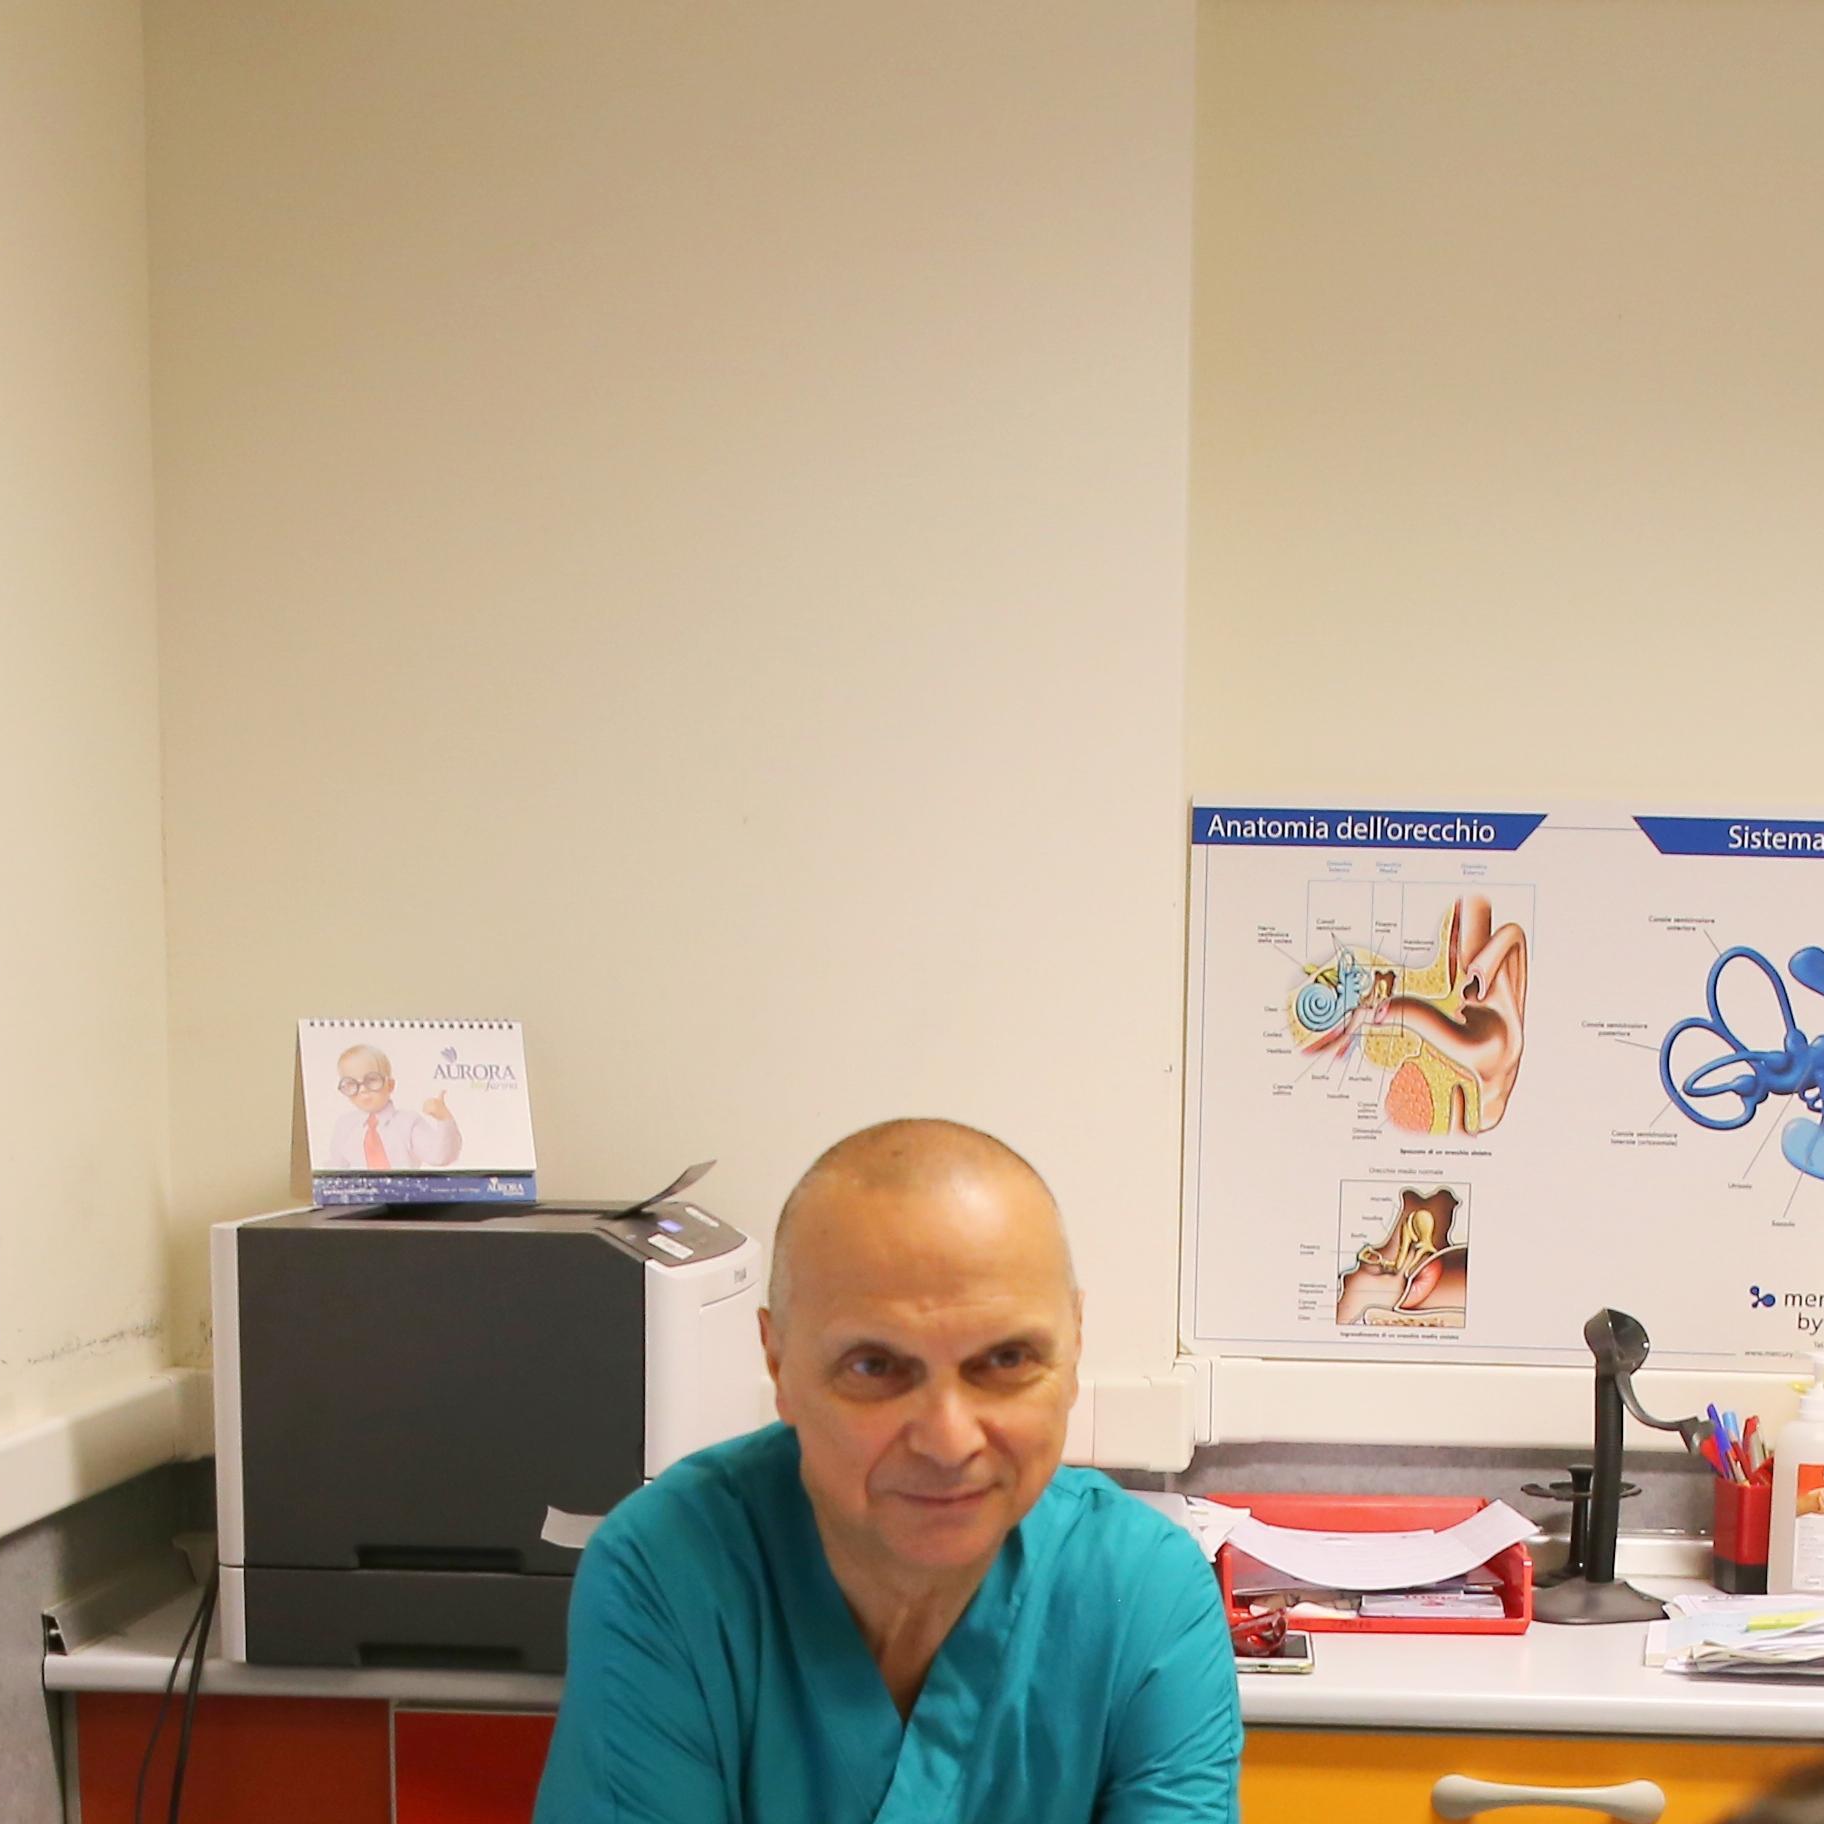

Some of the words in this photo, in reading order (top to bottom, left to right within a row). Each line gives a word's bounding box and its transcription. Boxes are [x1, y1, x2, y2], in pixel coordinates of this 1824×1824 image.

[1207, 814, 1329, 840] Anatomia
[1337, 816, 1496, 843] dell'orecchio
[433, 1064, 517, 1080] AURORA
[1797, 1312, 1824, 1336] by
